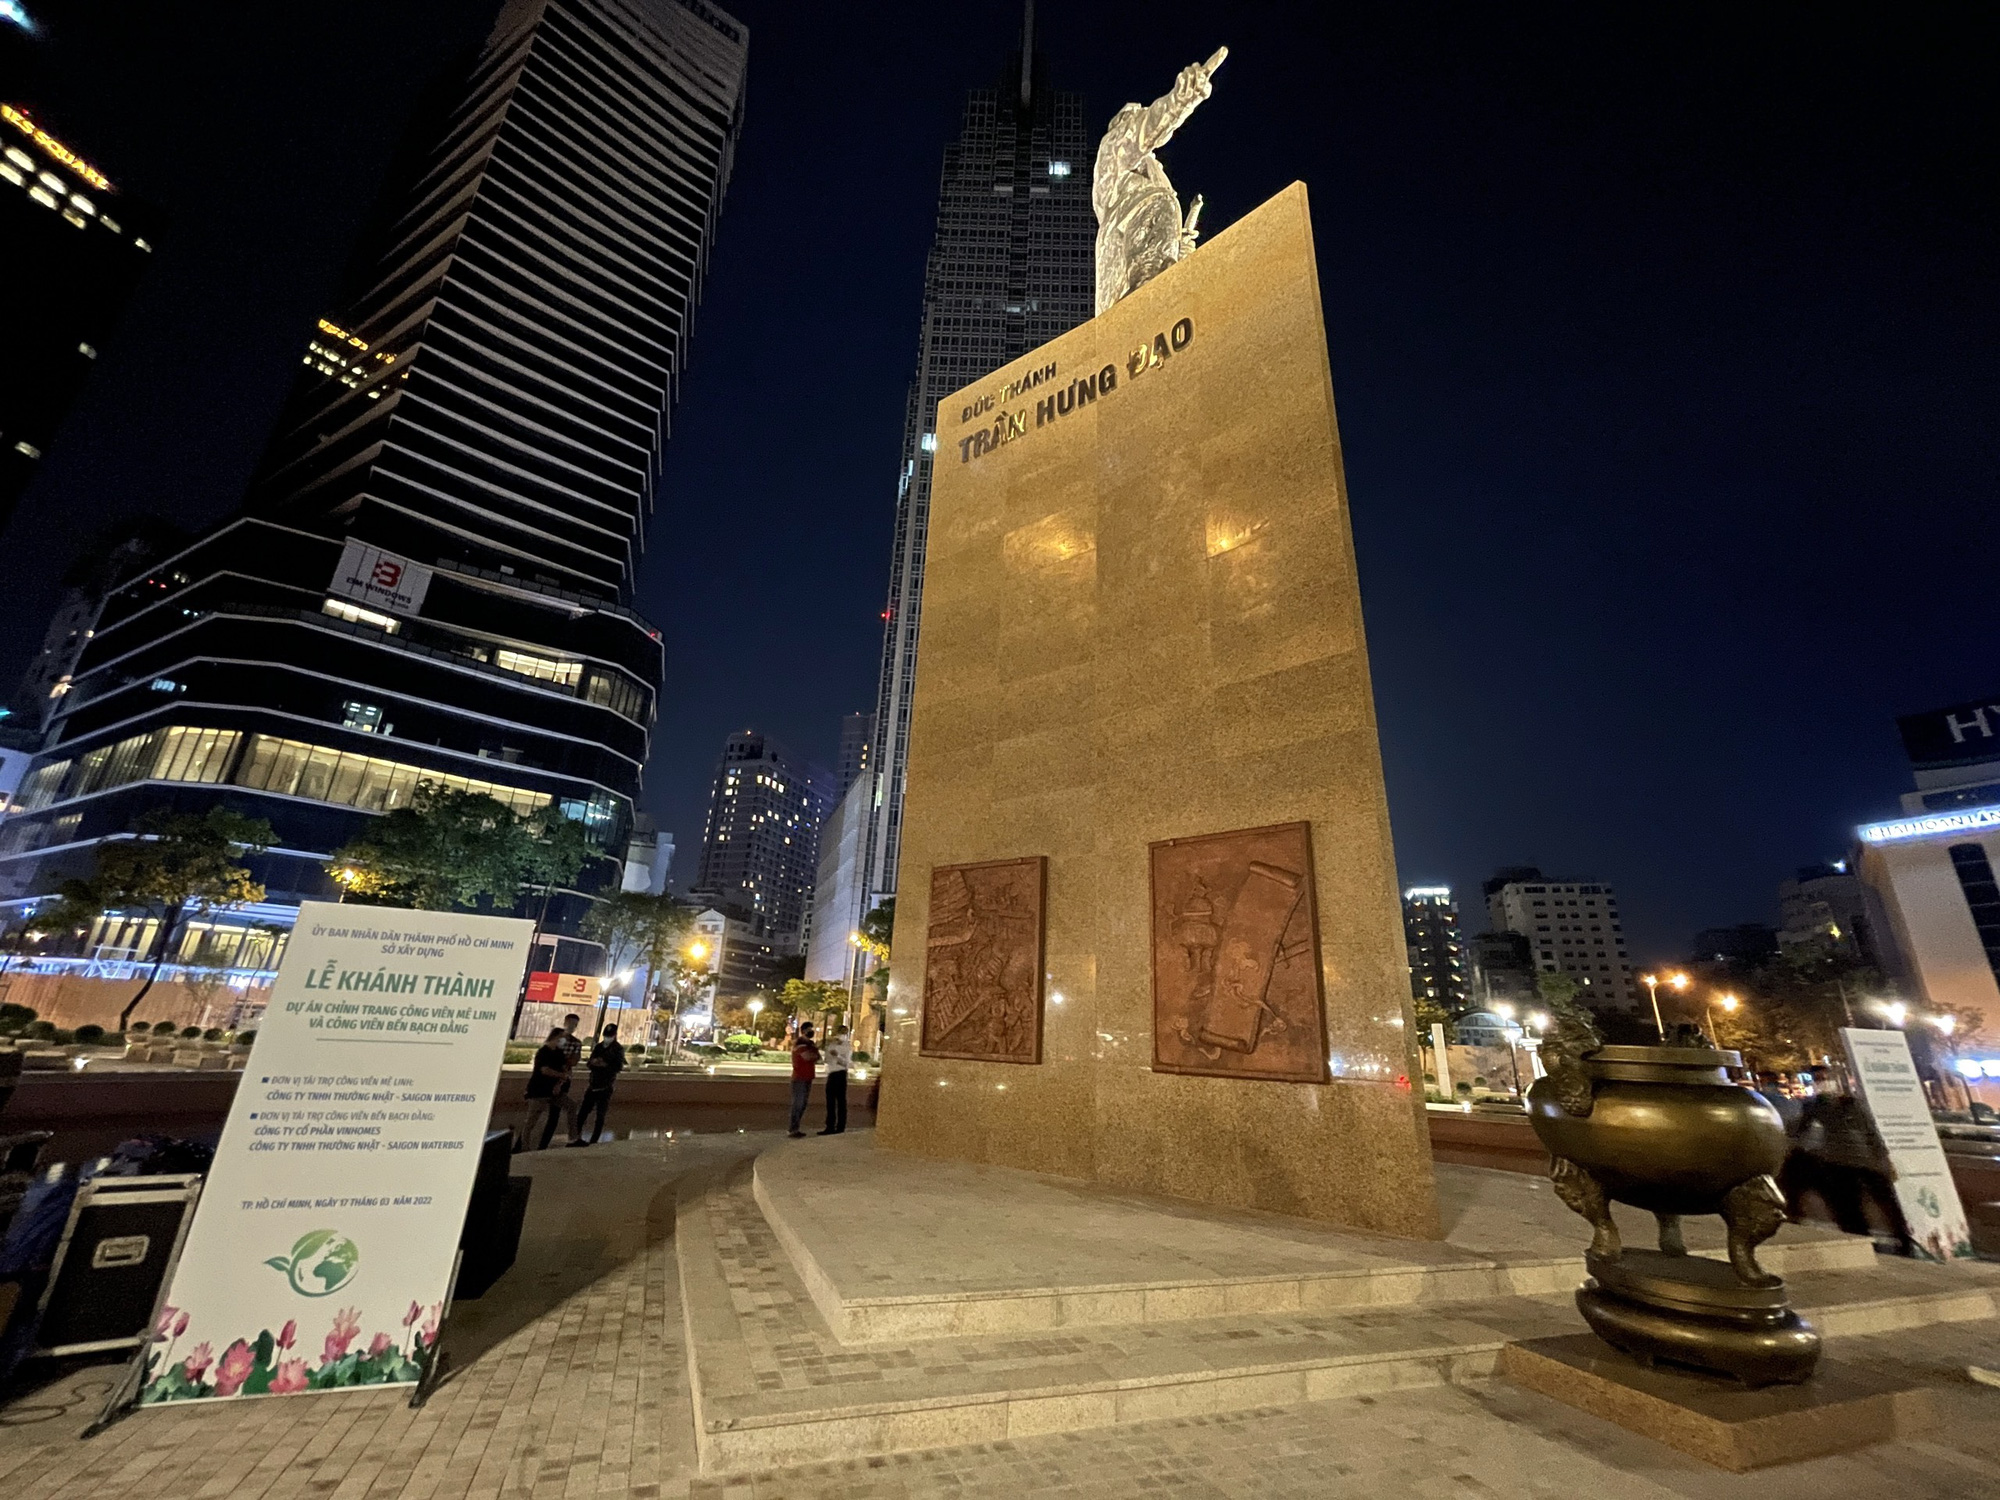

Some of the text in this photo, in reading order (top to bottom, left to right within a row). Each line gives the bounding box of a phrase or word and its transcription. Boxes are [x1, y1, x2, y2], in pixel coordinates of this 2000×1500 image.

[34, 130, 110, 190] SQUARE
[958, 317, 1194, 463] TRẦN HƯNG ĐẠO
[961, 361, 1057, 423] ĐỨC THÁNH
[365, 583, 412, 604] WINDOWS
[328, 928, 349, 938] BAN
[351, 928, 379, 940] NHÂN
[380, 930, 401, 941] DÂN
[436, 934, 458, 946] PHỐ
[458, 934, 472, 946] HỒ
[474, 938, 490, 948] CHÍ
[490, 940, 514, 950] MINH
[381, 942, 444, 958] SỞ XÂY DỰNG
[304, 959, 495, 998] LỄ KHÁNH THÀNH
[286, 1000, 496, 1020] DỰ ÁN CHỈNH TRANG CÔNG VIÊN MÊ LINH
[309, 1016, 468, 1034] VÀ CÔNG VIÊN BẾN BẠCH ĐẰNG
[318, 1077, 334, 1086] TRỢ
[335, 1076, 358, 1085] CÔNG
[361, 1076, 379, 1086] VIÊN
[266, 1090, 292, 1100] CÔNG
[294, 1092, 306, 1100] TY
[308, 1092, 331, 1100] TNHH
[372, 1091, 395, 1103] NHẬT
[401, 1093, 432, 1102] SAIGON
[434, 1094, 476, 1102] WATERBUS
[308, 1112, 324, 1122] TRỢ
[325, 1110, 348, 1120] CÔNG
[351, 1111, 369, 1120] VIÊN
[370, 1110, 389, 1120] BẾN
[389, 1112, 409, 1122] BẠCH
[254, 1124, 280, 1135] CÔNG
[283, 1127, 294, 1135] TY
[310, 1123, 334, 1135] PHẦN
[337, 1127, 381, 1135] VINHOMES
[249, 1140, 275, 1151] CÔNG
[278, 1142, 289, 1151] TY
[291, 1142, 316, 1150] TNHH
[357, 1139, 380, 1152] NHẬT
[387, 1141, 419, 1150] SAIGON
[421, 1141, 464, 1150] WATERBUS
[242, 1195, 432, 1210] TP. HỒ CHÍ MINH, NGÀY 17 THÁNG 03 NĂM 2022
